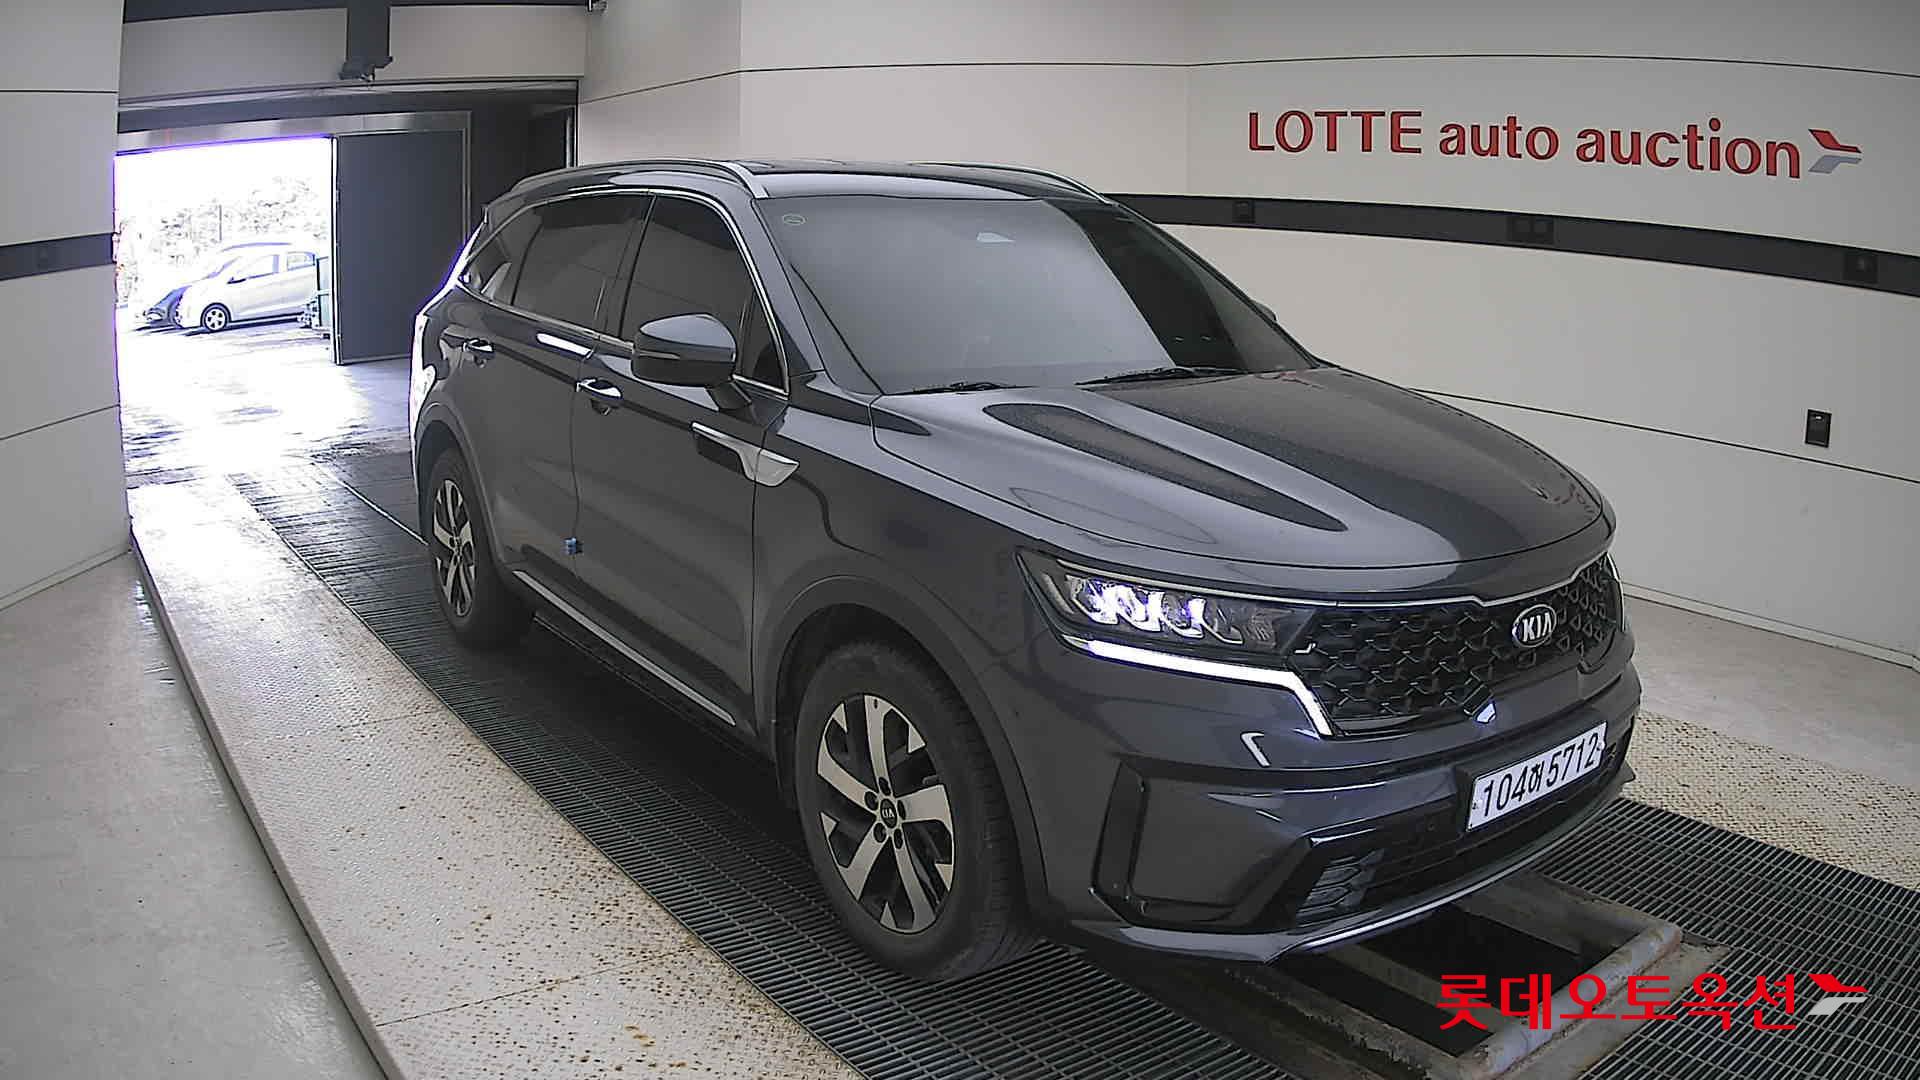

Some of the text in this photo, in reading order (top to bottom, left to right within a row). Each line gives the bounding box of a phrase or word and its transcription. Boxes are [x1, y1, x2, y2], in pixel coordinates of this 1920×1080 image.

[1248, 111, 1801, 179] LOTTE auto auction
[1522, 612, 1552, 642] KIA
